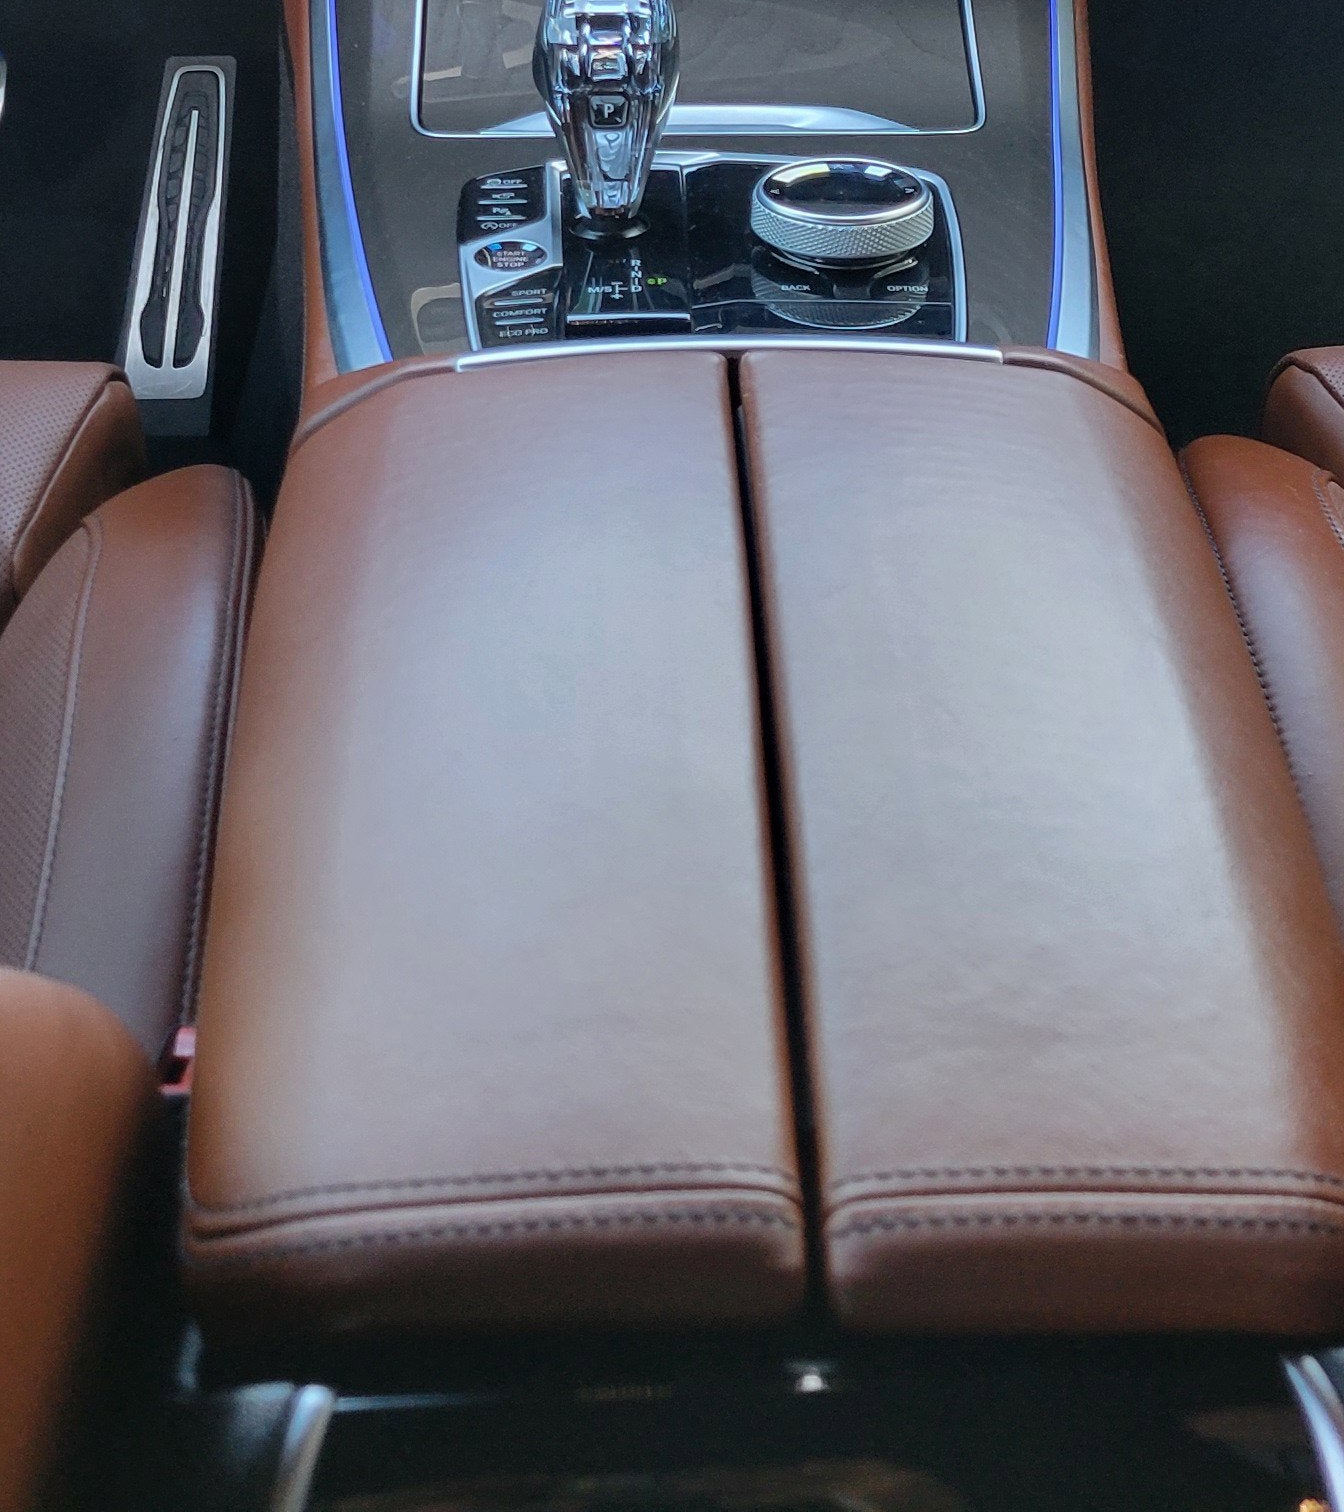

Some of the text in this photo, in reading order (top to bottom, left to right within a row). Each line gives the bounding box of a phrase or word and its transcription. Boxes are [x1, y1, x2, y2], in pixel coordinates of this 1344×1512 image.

[604, 103, 615, 118] P
[631, 259, 642, 267] R
[631, 270, 642, 278] N
[511, 288, 548, 297] SPORT
[587, 285, 642, 294] M/S D
[886, 285, 929, 293] OPTION
[492, 308, 548, 318] COMFORT
[524, 328, 549, 336] PRO
